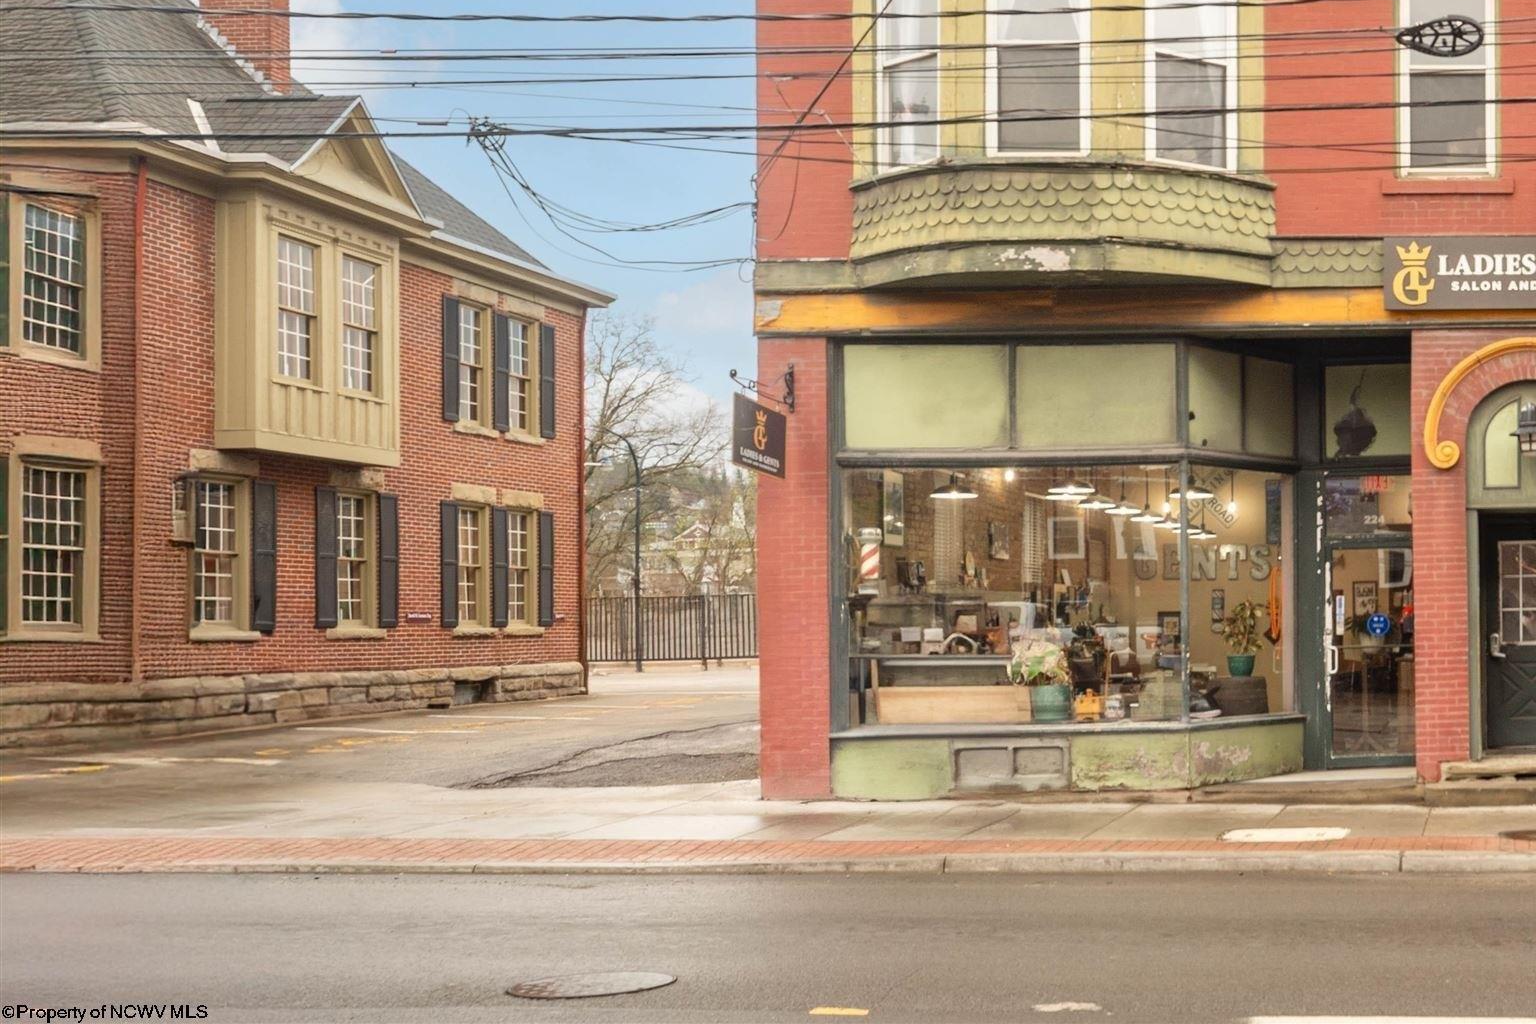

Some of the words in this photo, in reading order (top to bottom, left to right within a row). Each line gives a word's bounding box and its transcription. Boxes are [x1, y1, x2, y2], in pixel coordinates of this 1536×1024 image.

[1437, 253, 1536, 276] LADIES
[1451, 281, 1502, 291] SALON
[1207, 497, 1234, 524] ROAD
